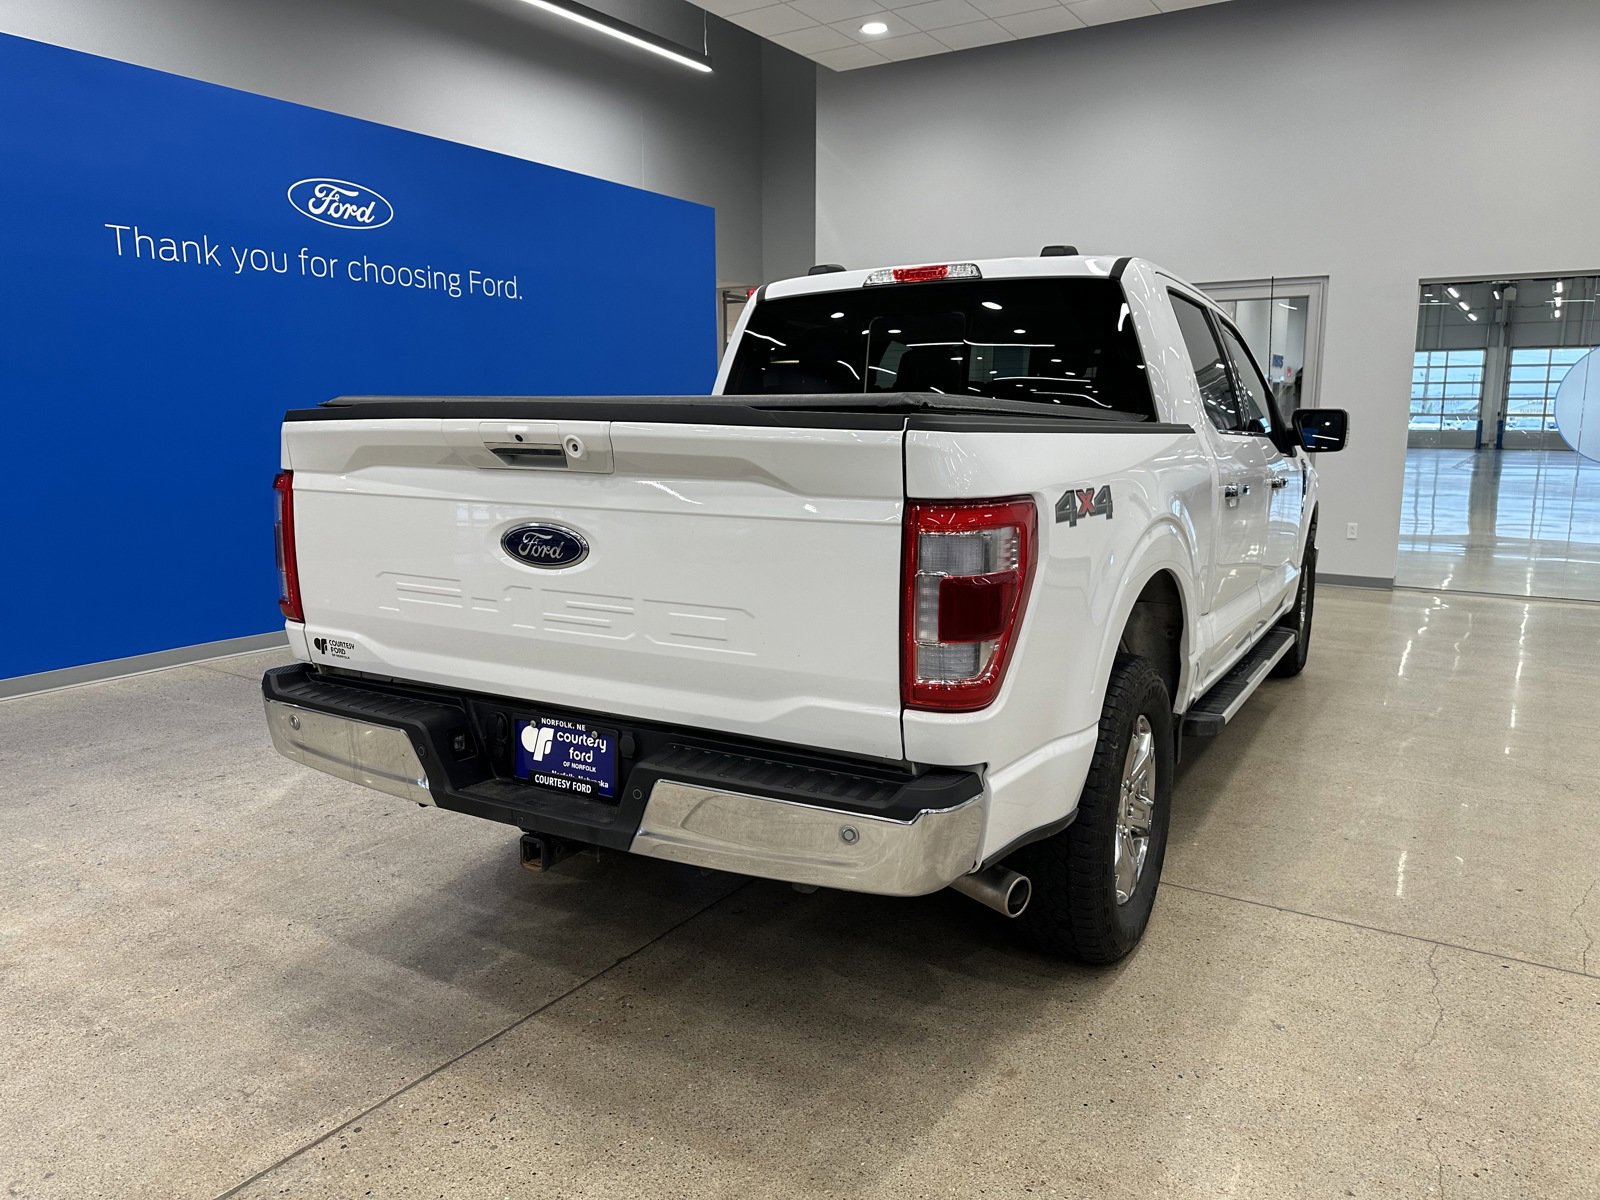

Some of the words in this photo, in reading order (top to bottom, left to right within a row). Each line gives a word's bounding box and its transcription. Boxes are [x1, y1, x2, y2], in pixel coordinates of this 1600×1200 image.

[308, 184, 376, 224] Ford
[104, 223, 222, 267] Thank
[230, 246, 288, 275] you
[298, 247, 338, 279] for
[347, 255, 462, 298] choosing
[469, 270, 523, 300] Ford.
[518, 531, 565, 559] Ford
[329, 640, 354, 649] COURTESY
[557, 732, 606, 753] courtesy
[569, 747, 593, 762] ford
[571, 762, 597, 773] NORFOLK
[534, 773, 571, 789] COURTESY
[572, 781, 592, 794] FORD
